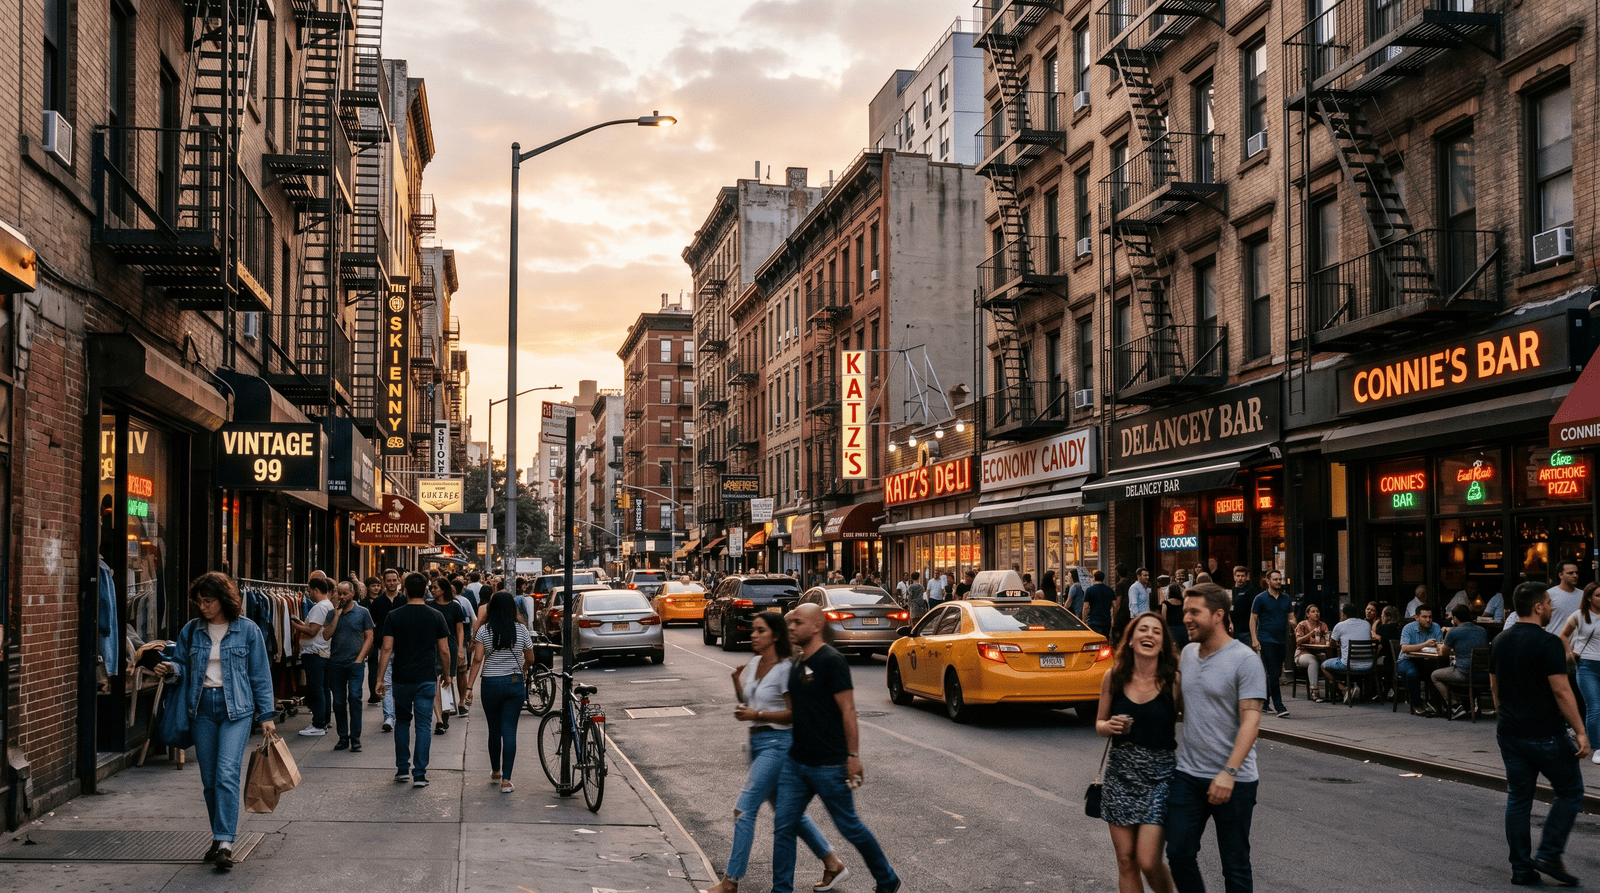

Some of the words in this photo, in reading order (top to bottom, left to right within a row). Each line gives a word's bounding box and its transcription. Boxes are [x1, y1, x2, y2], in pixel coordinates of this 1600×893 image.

[388, 316, 403, 432] SKIENNY
[1353, 347, 1468, 404] CONNIE'S
[1477, 329, 1541, 379] BAR
[845, 352, 863, 476] KATZ'S
[1120, 407, 1214, 458] DELANCEY
[1218, 396, 1264, 439] BAR
[222, 431, 314, 456] VINTAGE
[253, 458, 282, 482] 99
[983, 448, 1037, 484] ECONOMY
[1041, 436, 1086, 473] CANDY
[885, 467, 928, 504] KATZ'S
[934, 456, 971, 494] DELI
[1380, 472, 1425, 492] CONNIE'S
[1539, 465, 1586, 481] ARTICHOKE
[1125, 480, 1163, 498] DELANCEY
[1163, 478, 1180, 493] BAR
[1392, 492, 1413, 508] BAR
[1548, 481, 1578, 495] PIZZA
[360, 522, 382, 533] CAFE
[383, 522, 426, 534] CENTRALE
